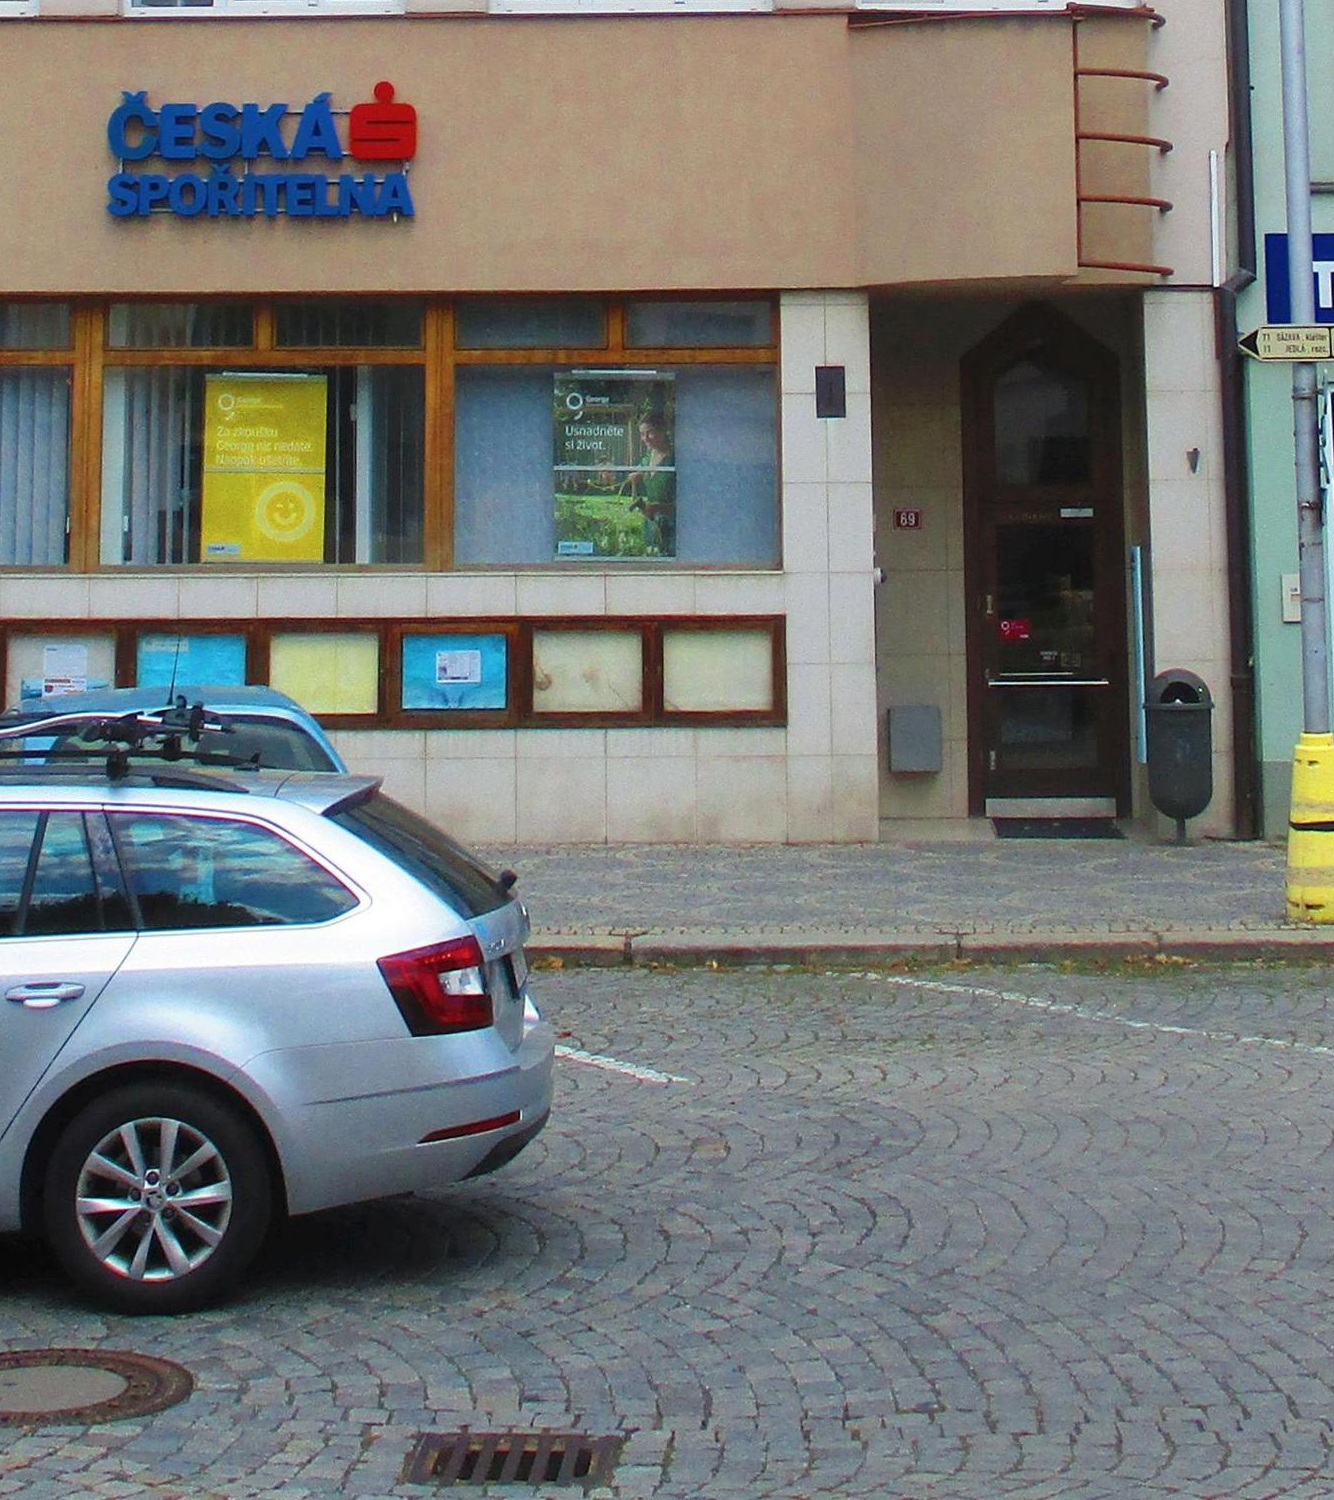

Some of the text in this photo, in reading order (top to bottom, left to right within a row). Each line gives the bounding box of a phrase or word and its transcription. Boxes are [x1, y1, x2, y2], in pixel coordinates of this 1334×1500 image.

[107, 91, 343, 160] ČESKÁ
[108, 164, 414, 216] SPOŘITELNA
[565, 425, 624, 437] Usnadněte
[565, 439, 575, 450] si
[900, 512, 915, 526] 69
